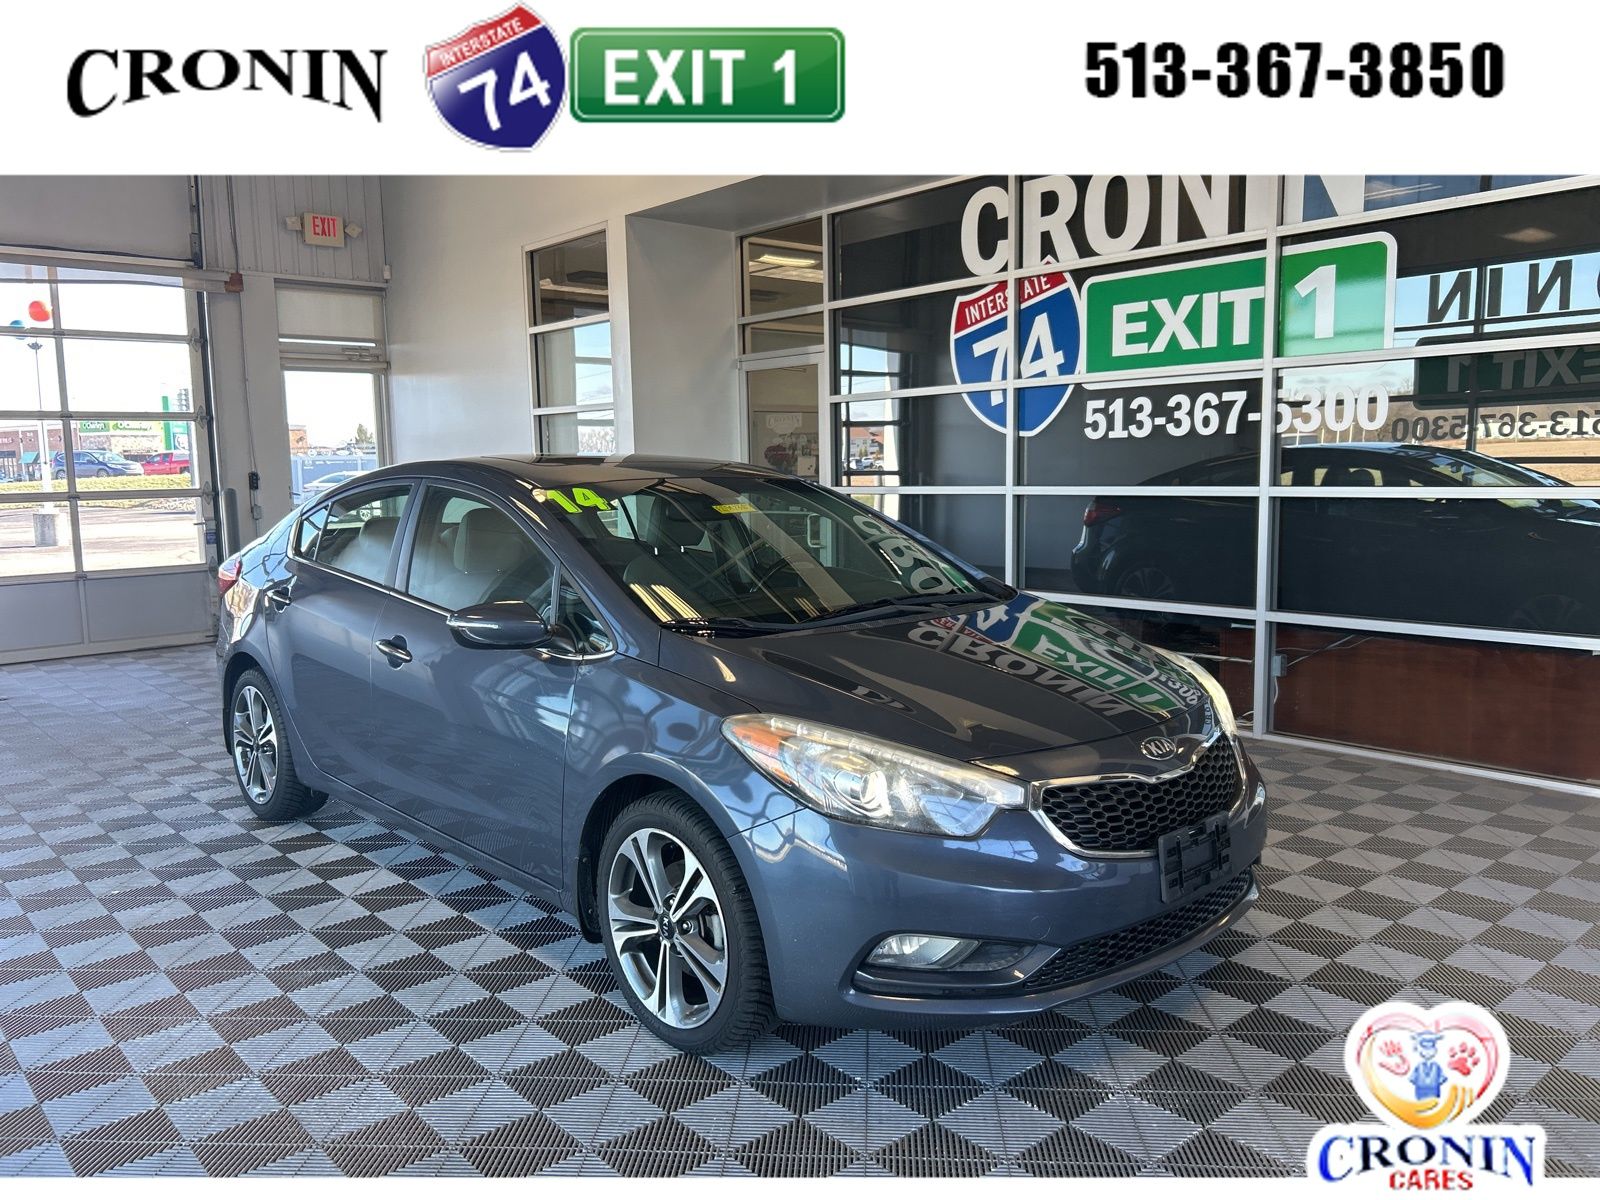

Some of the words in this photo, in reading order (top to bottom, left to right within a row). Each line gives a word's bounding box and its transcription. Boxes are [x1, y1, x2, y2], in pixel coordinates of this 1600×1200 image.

[312, 215, 337, 238] EXIT
[964, 273, 1051, 326] INTERATE
[1112, 286, 1266, 357] EXIT
[1294, 264, 1337, 339] 1
[971, 311, 1065, 407] 74
[1084, 384, 1389, 440] 513-367-5300
[546, 487, 612, 513] 14
[1145, 739, 1174, 756] KIA
